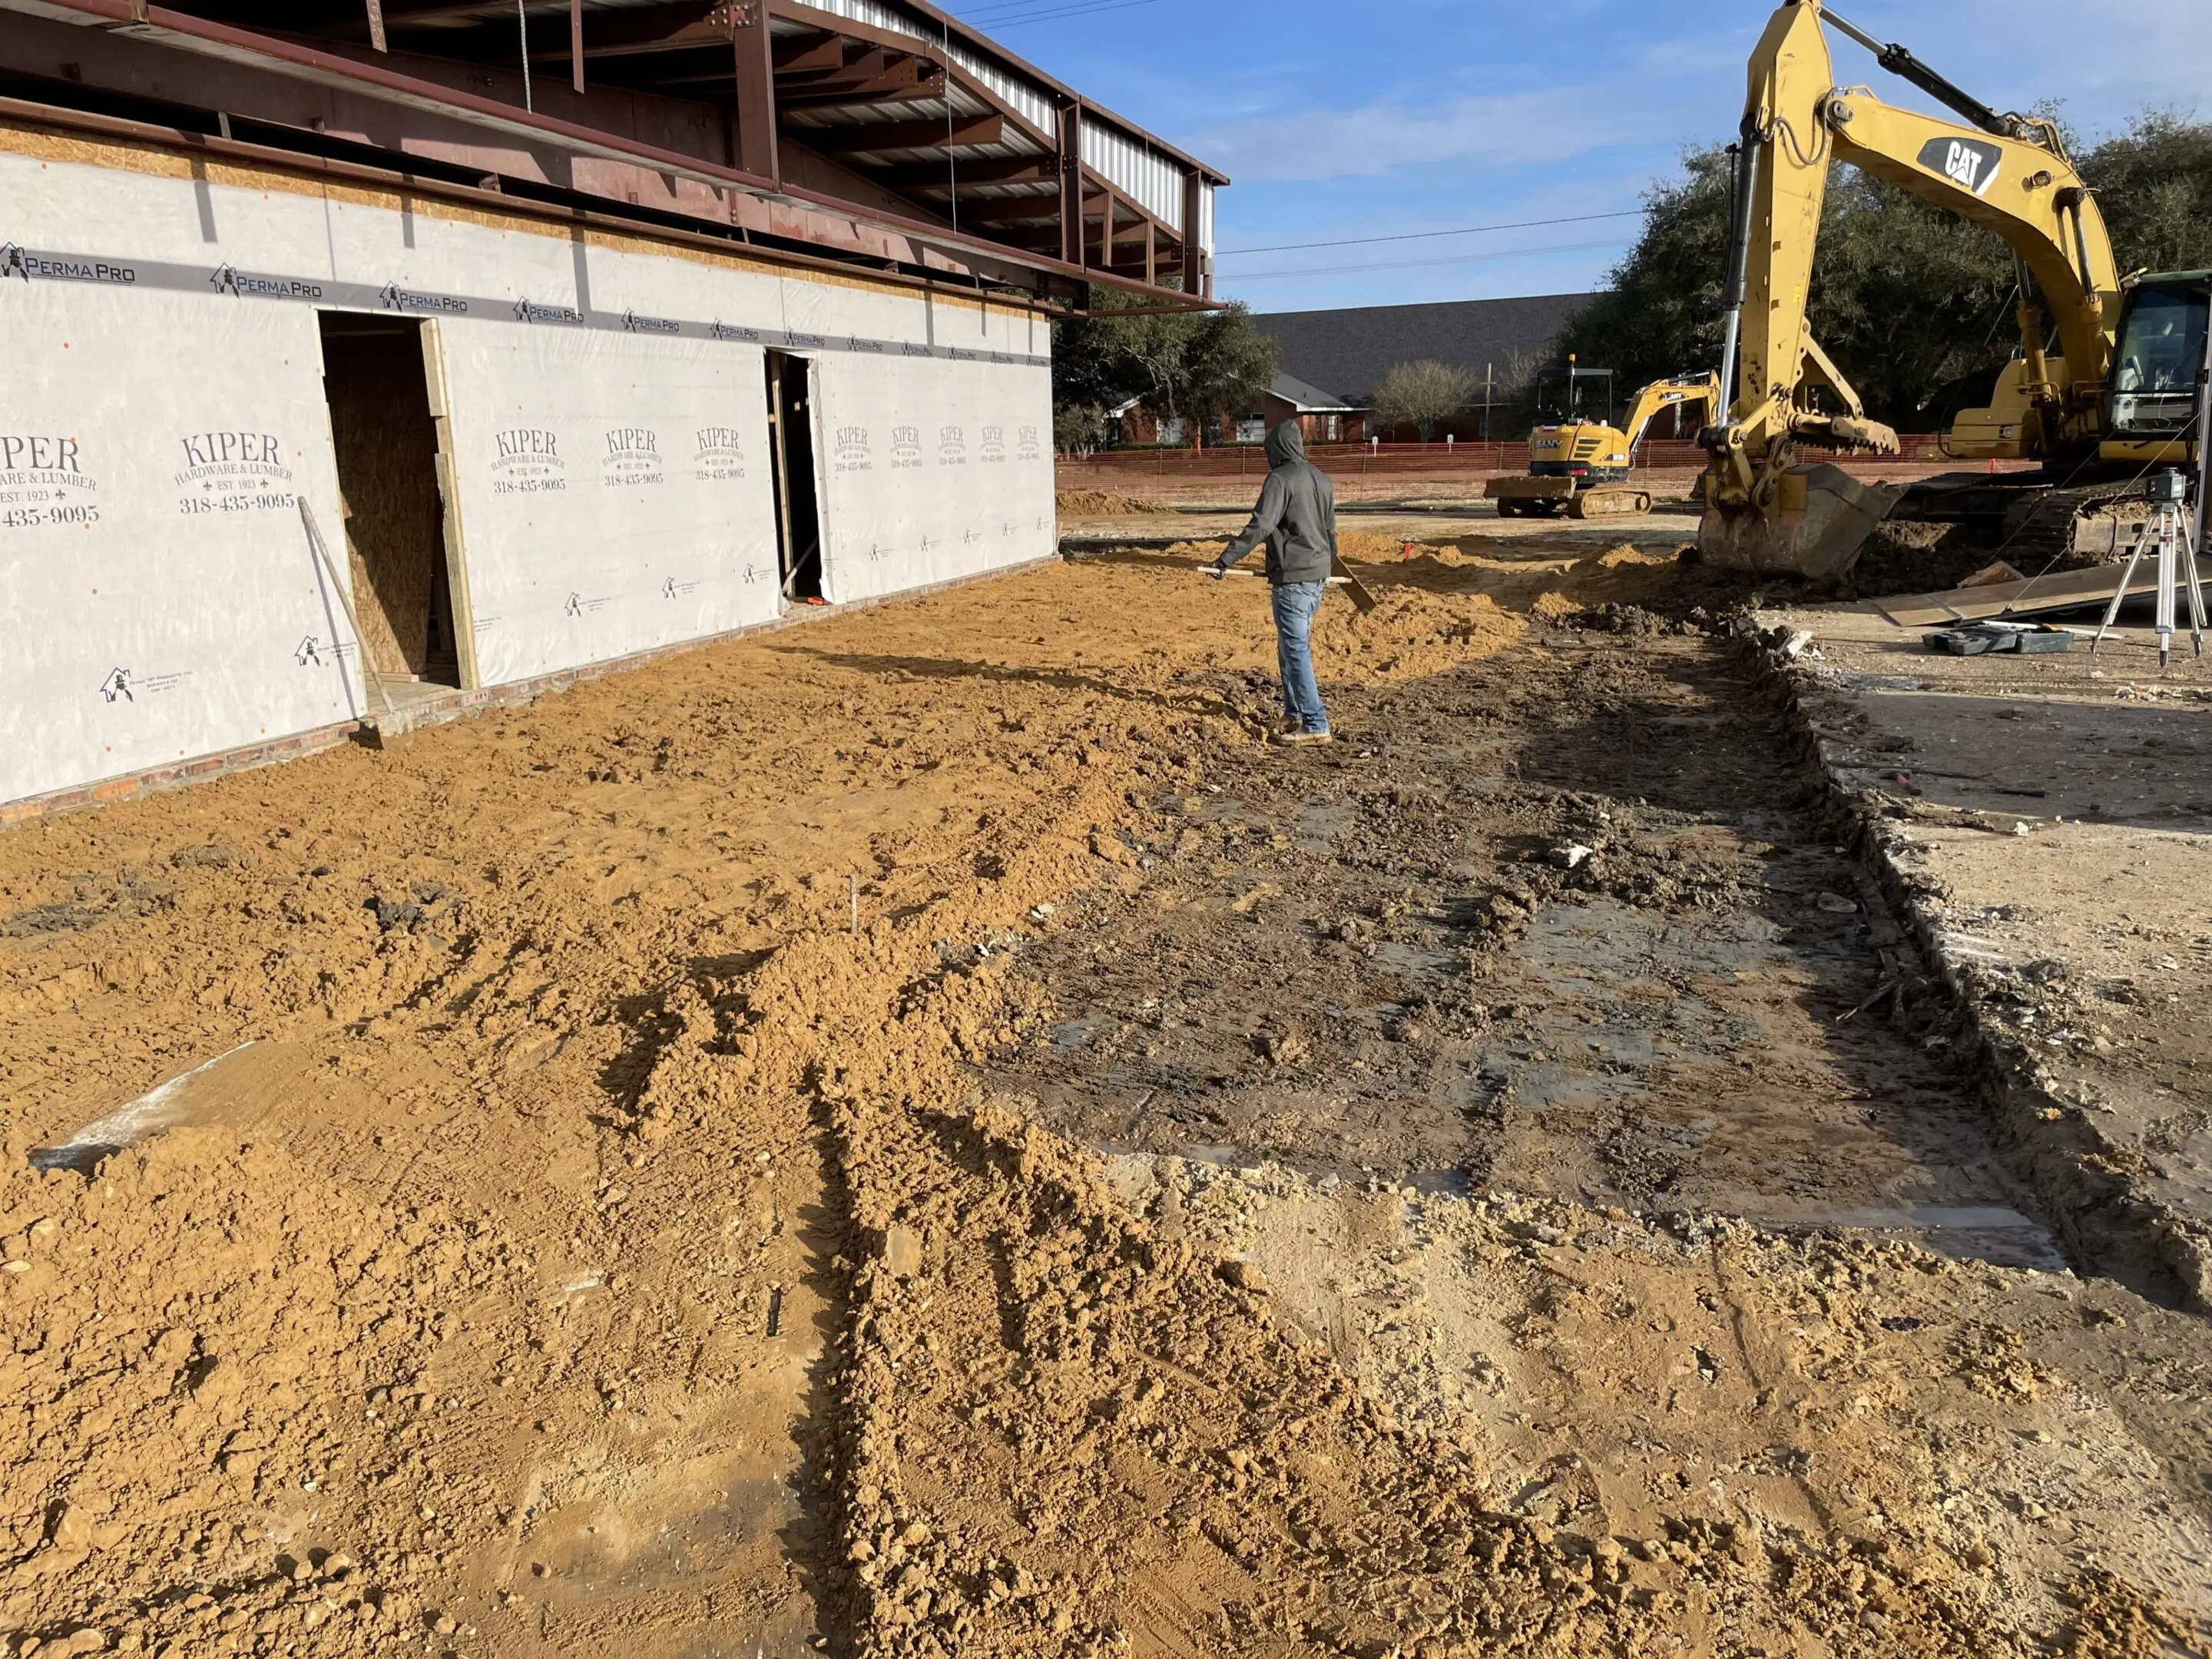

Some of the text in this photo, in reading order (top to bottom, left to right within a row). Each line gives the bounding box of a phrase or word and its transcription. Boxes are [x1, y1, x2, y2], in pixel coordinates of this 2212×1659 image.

[1945, 141, 1982, 190] CAT
[25, 257, 94, 278] PERMA
[96, 263, 135, 282] PRO
[237, 276, 290, 294] PERMA
[291, 282, 322, 298] PRO
[400, 293, 468, 312] PERMA PRO
[530, 306, 584, 323] PERMA PRO
[634, 316, 679, 332] PERMA PRO
[721, 326, 758, 339] PERMA PRO
[793, 333, 825, 346] PERMA PRO
[605, 428, 656, 453] KIPER
[697, 427, 739, 450] KIPER
[836, 426, 868, 446] KIPER
[892, 426, 919, 444] KIPER
[939, 426, 963, 443] KIPER
[982, 426, 1002, 442] KIPER
[180, 432, 280, 468] KIPER
[495, 429, 557, 458] KIPER
[0, 436, 81, 474] PER
[491, 454, 530, 472] HARDWARE
[41, 472, 97, 492] LUMBER
[174, 464, 238, 486] HARDWARE
[250, 464, 293, 482] LUMBER
[604, 473, 664, 487] 318-435-9095
[695, 468, 745, 480] 318-435-9095
[217, 480, 256, 491] EST. 1923
[494, 478, 566, 494] 318-435-9095
[0, 490, 49, 503] EST. 1923
[180, 493, 295, 515] 318-435-9095
